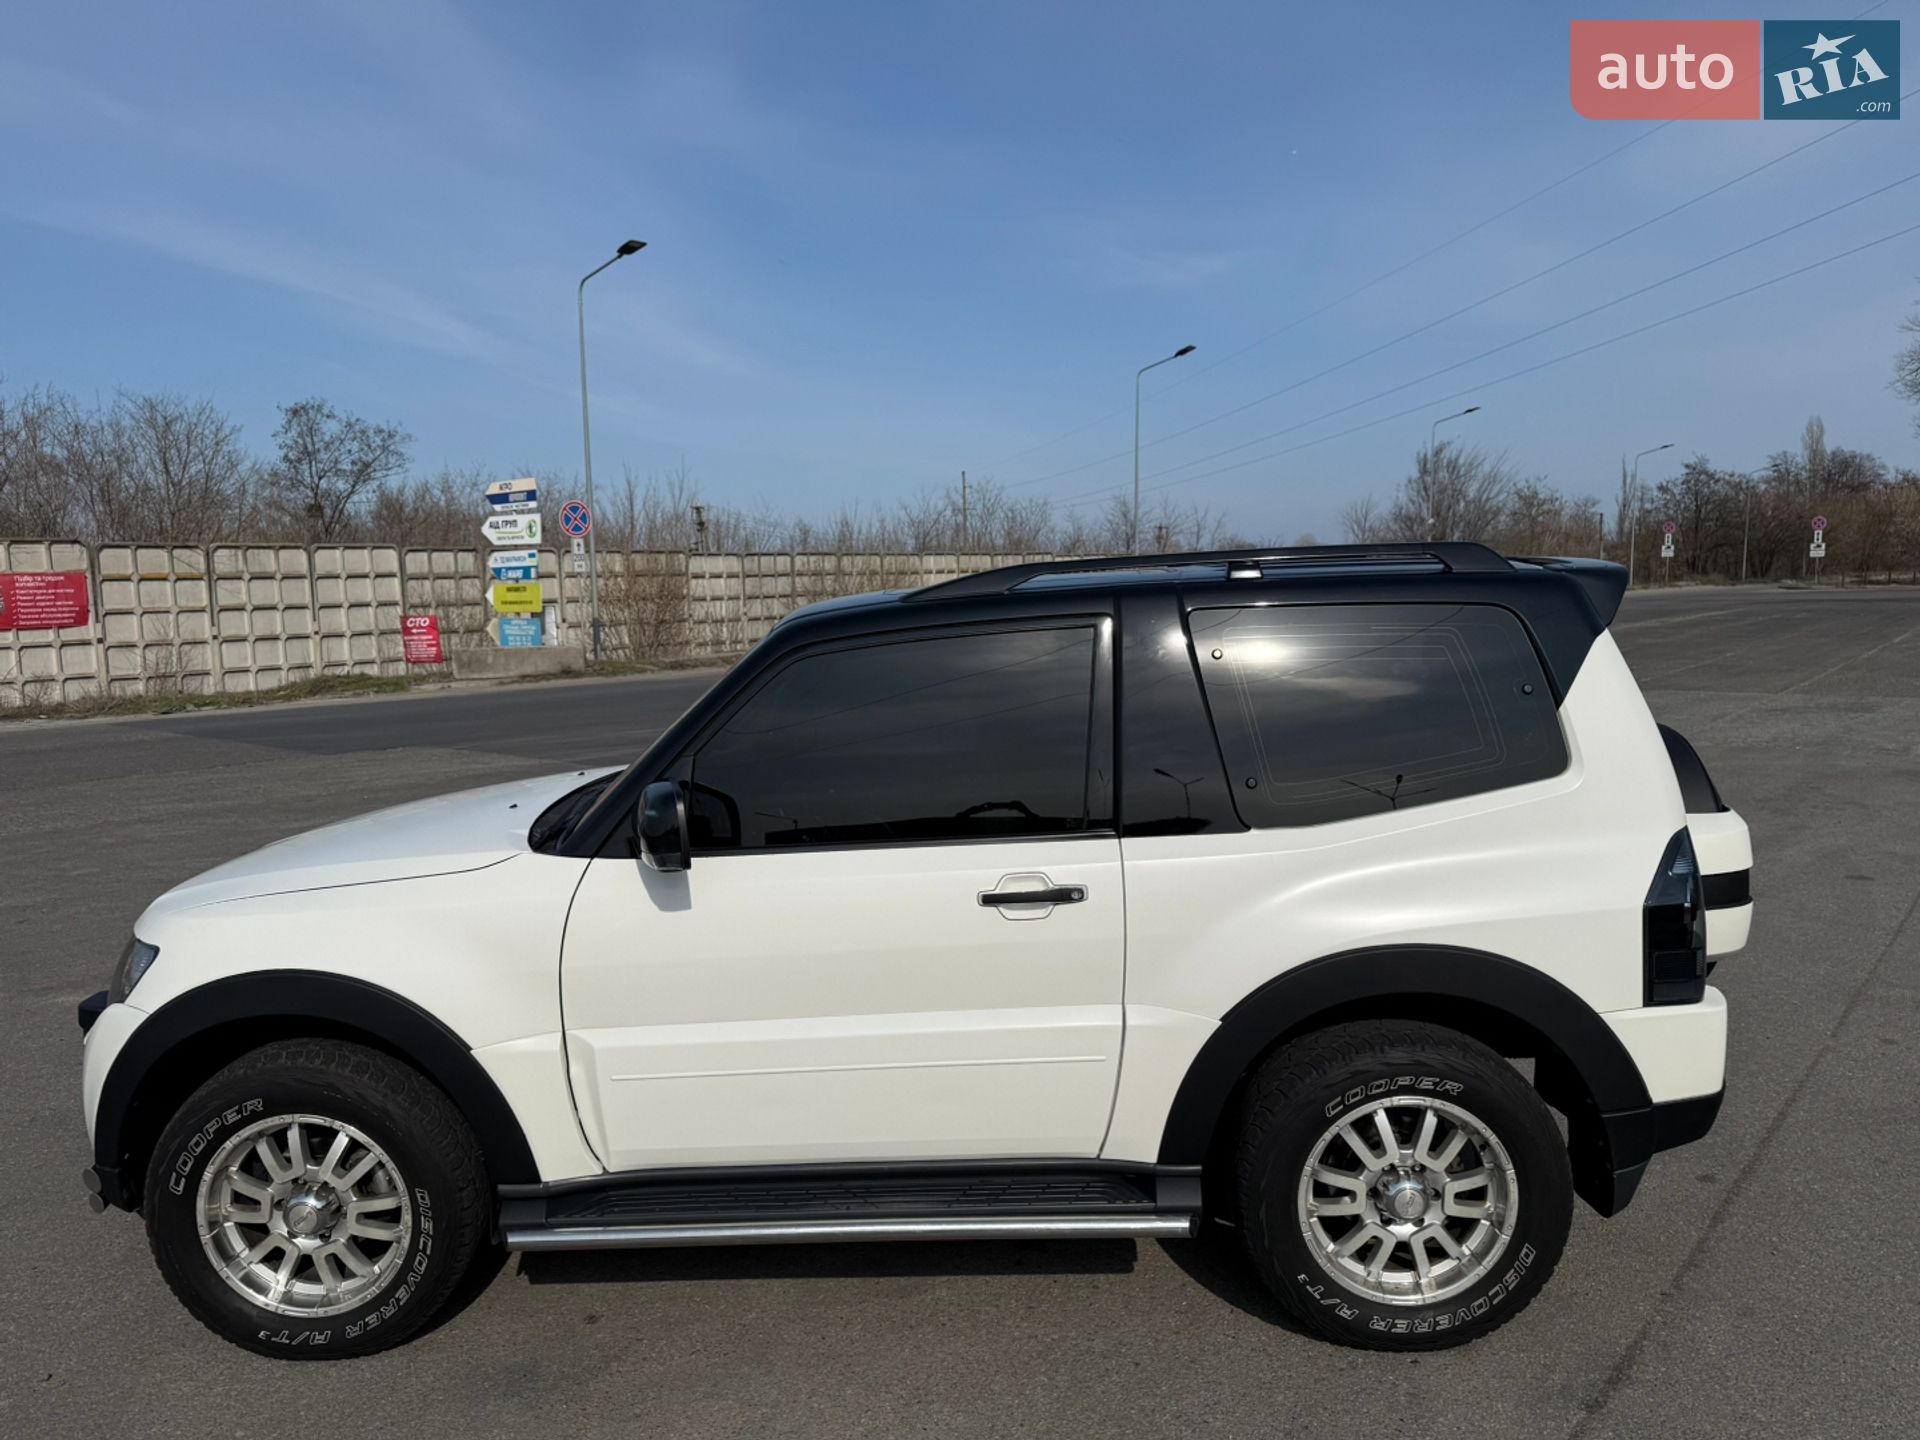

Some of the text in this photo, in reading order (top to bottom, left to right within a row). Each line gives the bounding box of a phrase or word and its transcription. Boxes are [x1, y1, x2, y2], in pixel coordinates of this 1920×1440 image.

[406, 617, 430, 628] СТО
[1325, 1076, 1464, 1118] COOPER
[169, 1097, 265, 1196] COOPER
[345, 1187, 433, 1339] DISCOVERER
[1369, 1243, 1536, 1333] DISCOVERER
